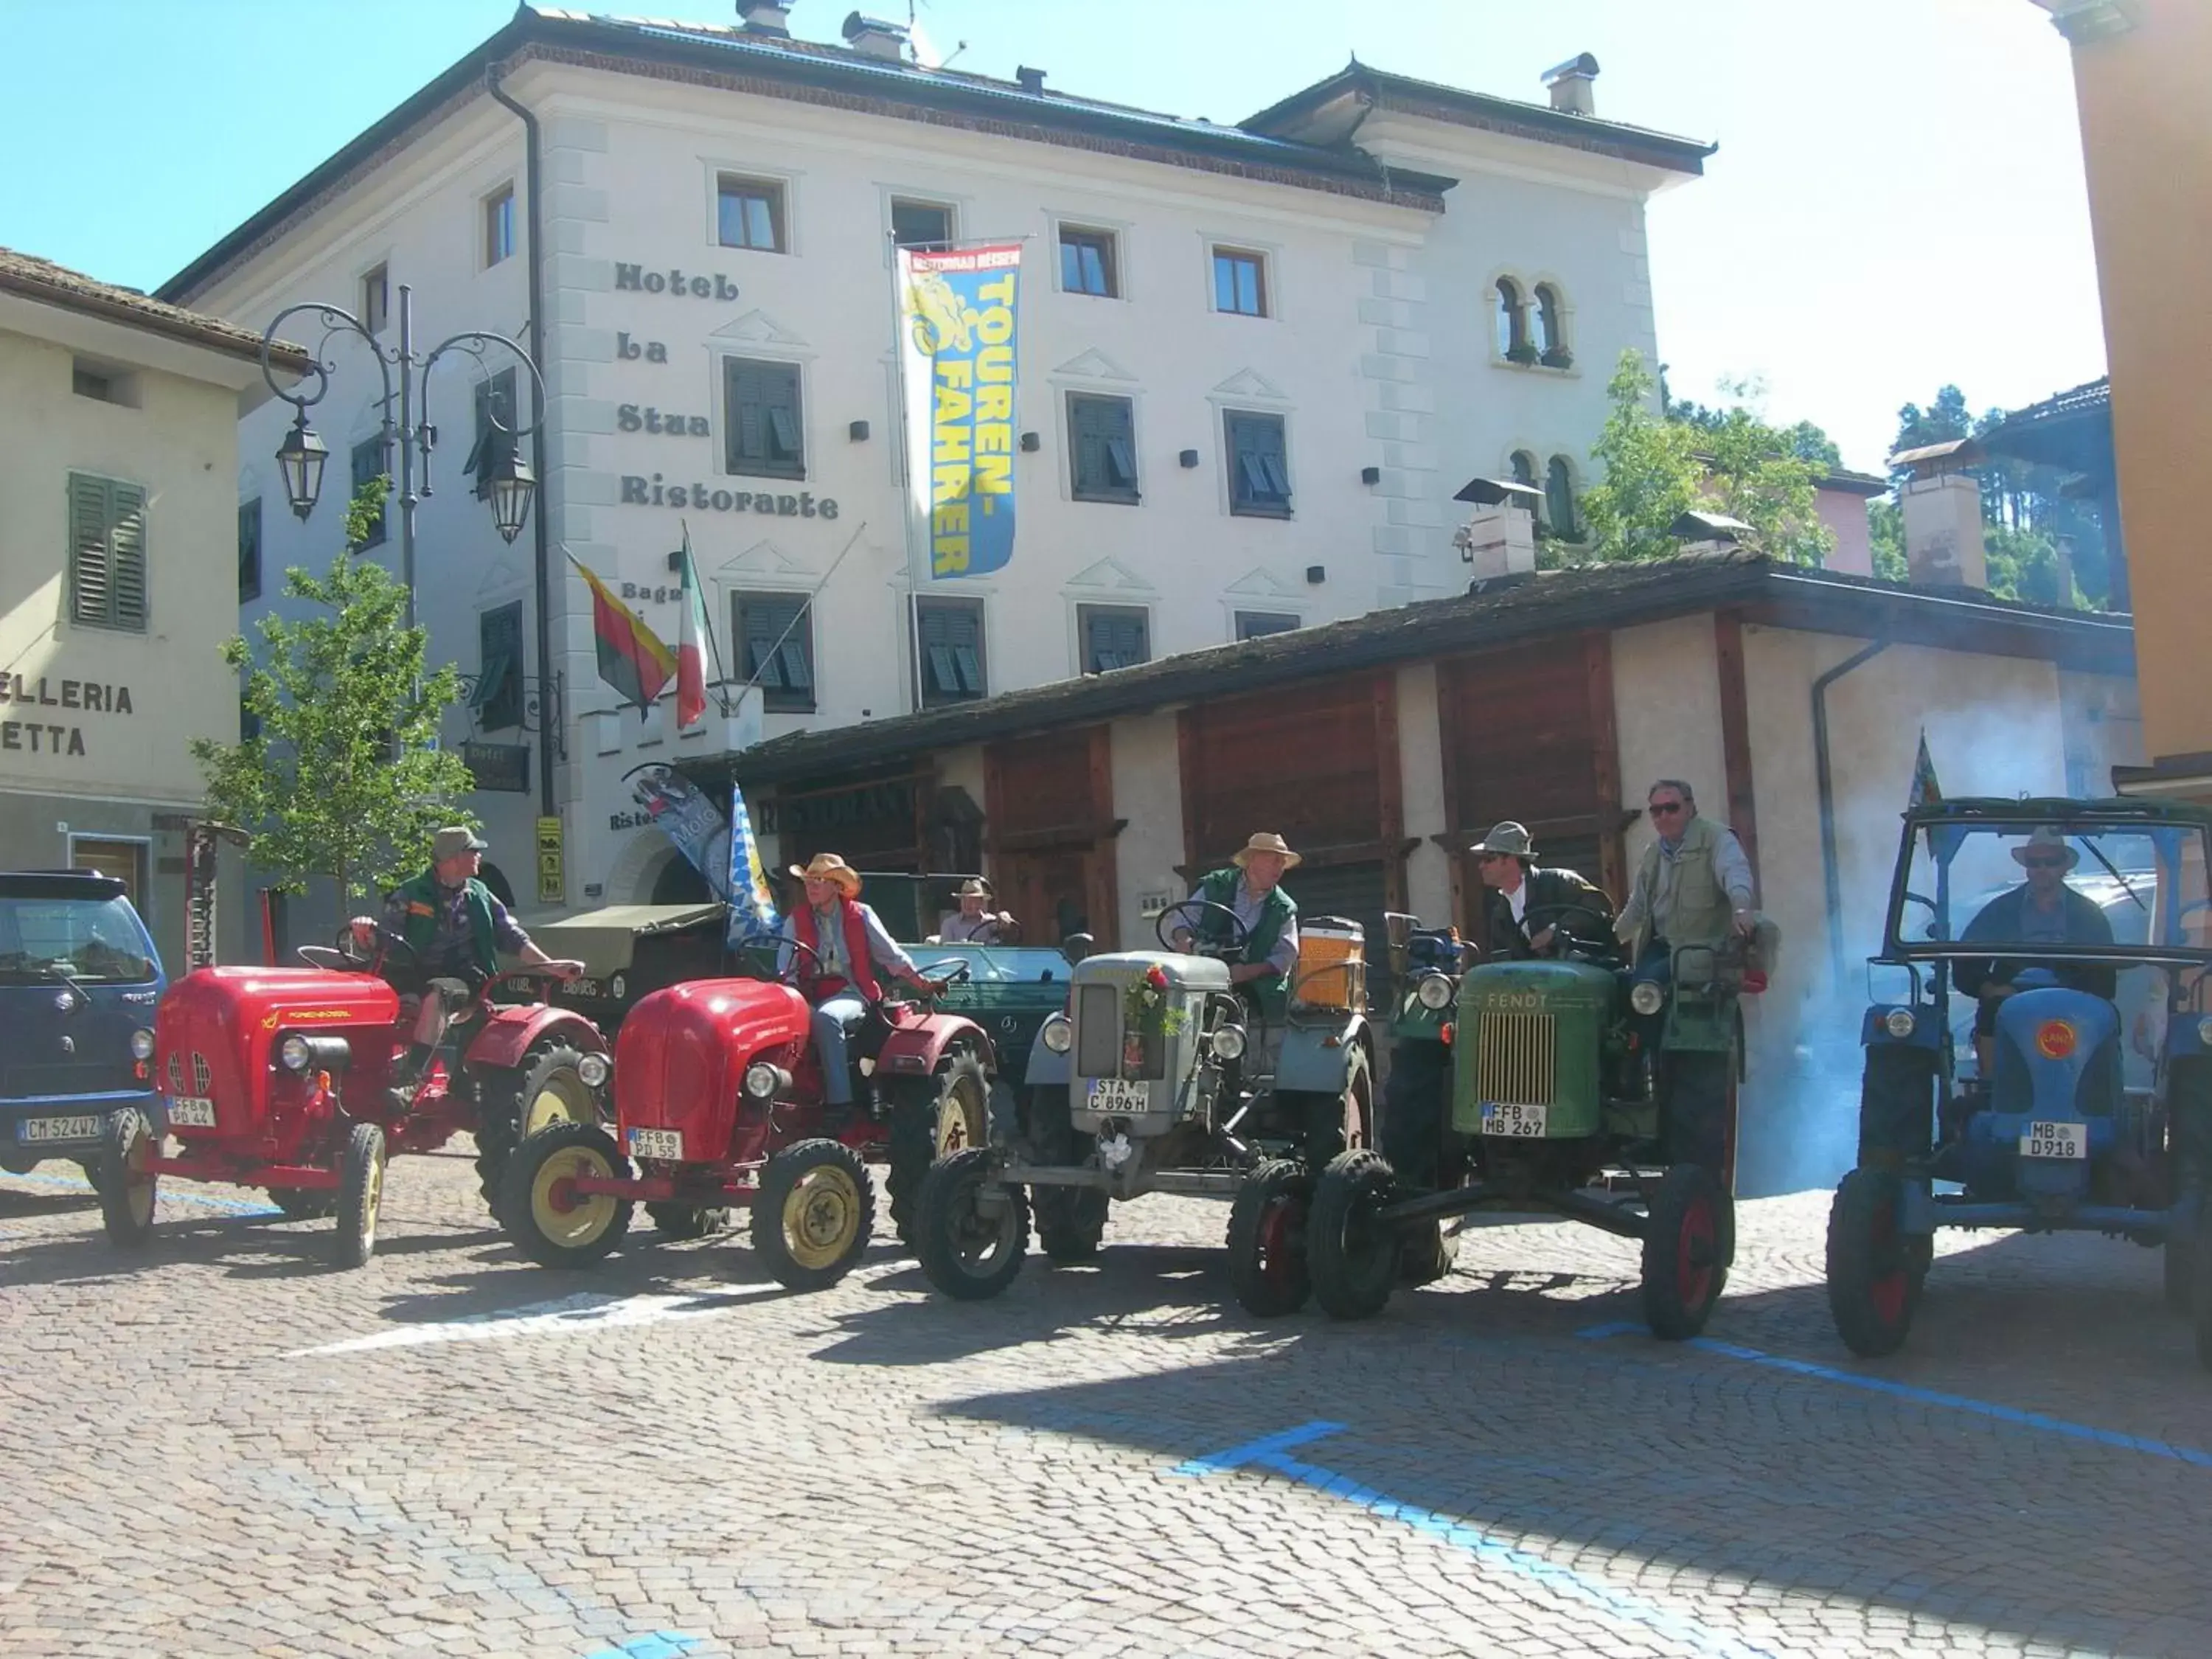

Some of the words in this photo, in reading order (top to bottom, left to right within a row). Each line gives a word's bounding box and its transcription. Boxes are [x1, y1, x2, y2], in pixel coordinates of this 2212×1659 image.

[615, 262, 740, 302] Hotel
[616, 331, 668, 364] La
[617, 403, 711, 438] Stua
[933, 359, 973, 577] FAHRER
[621, 473, 839, 520] Ristorante
[2, 720, 86, 757] ETTA
[676, 808, 717, 845] Moto
[1488, 993, 1547, 1009] FENDT
[1098, 1079, 1126, 1094] STA
[175, 1097, 198, 1111] FFB
[1492, 1104, 1523, 1120] FFB
[29, 1120, 48, 1138] CM
[1486, 1119, 1505, 1133] MB
[1512, 1121, 1543, 1135] 267
[2033, 1122, 2055, 1139] MB
[638, 1130, 664, 1144] FFB
[636, 1142, 653, 1156] PD
[658, 1144, 676, 1159] 55
